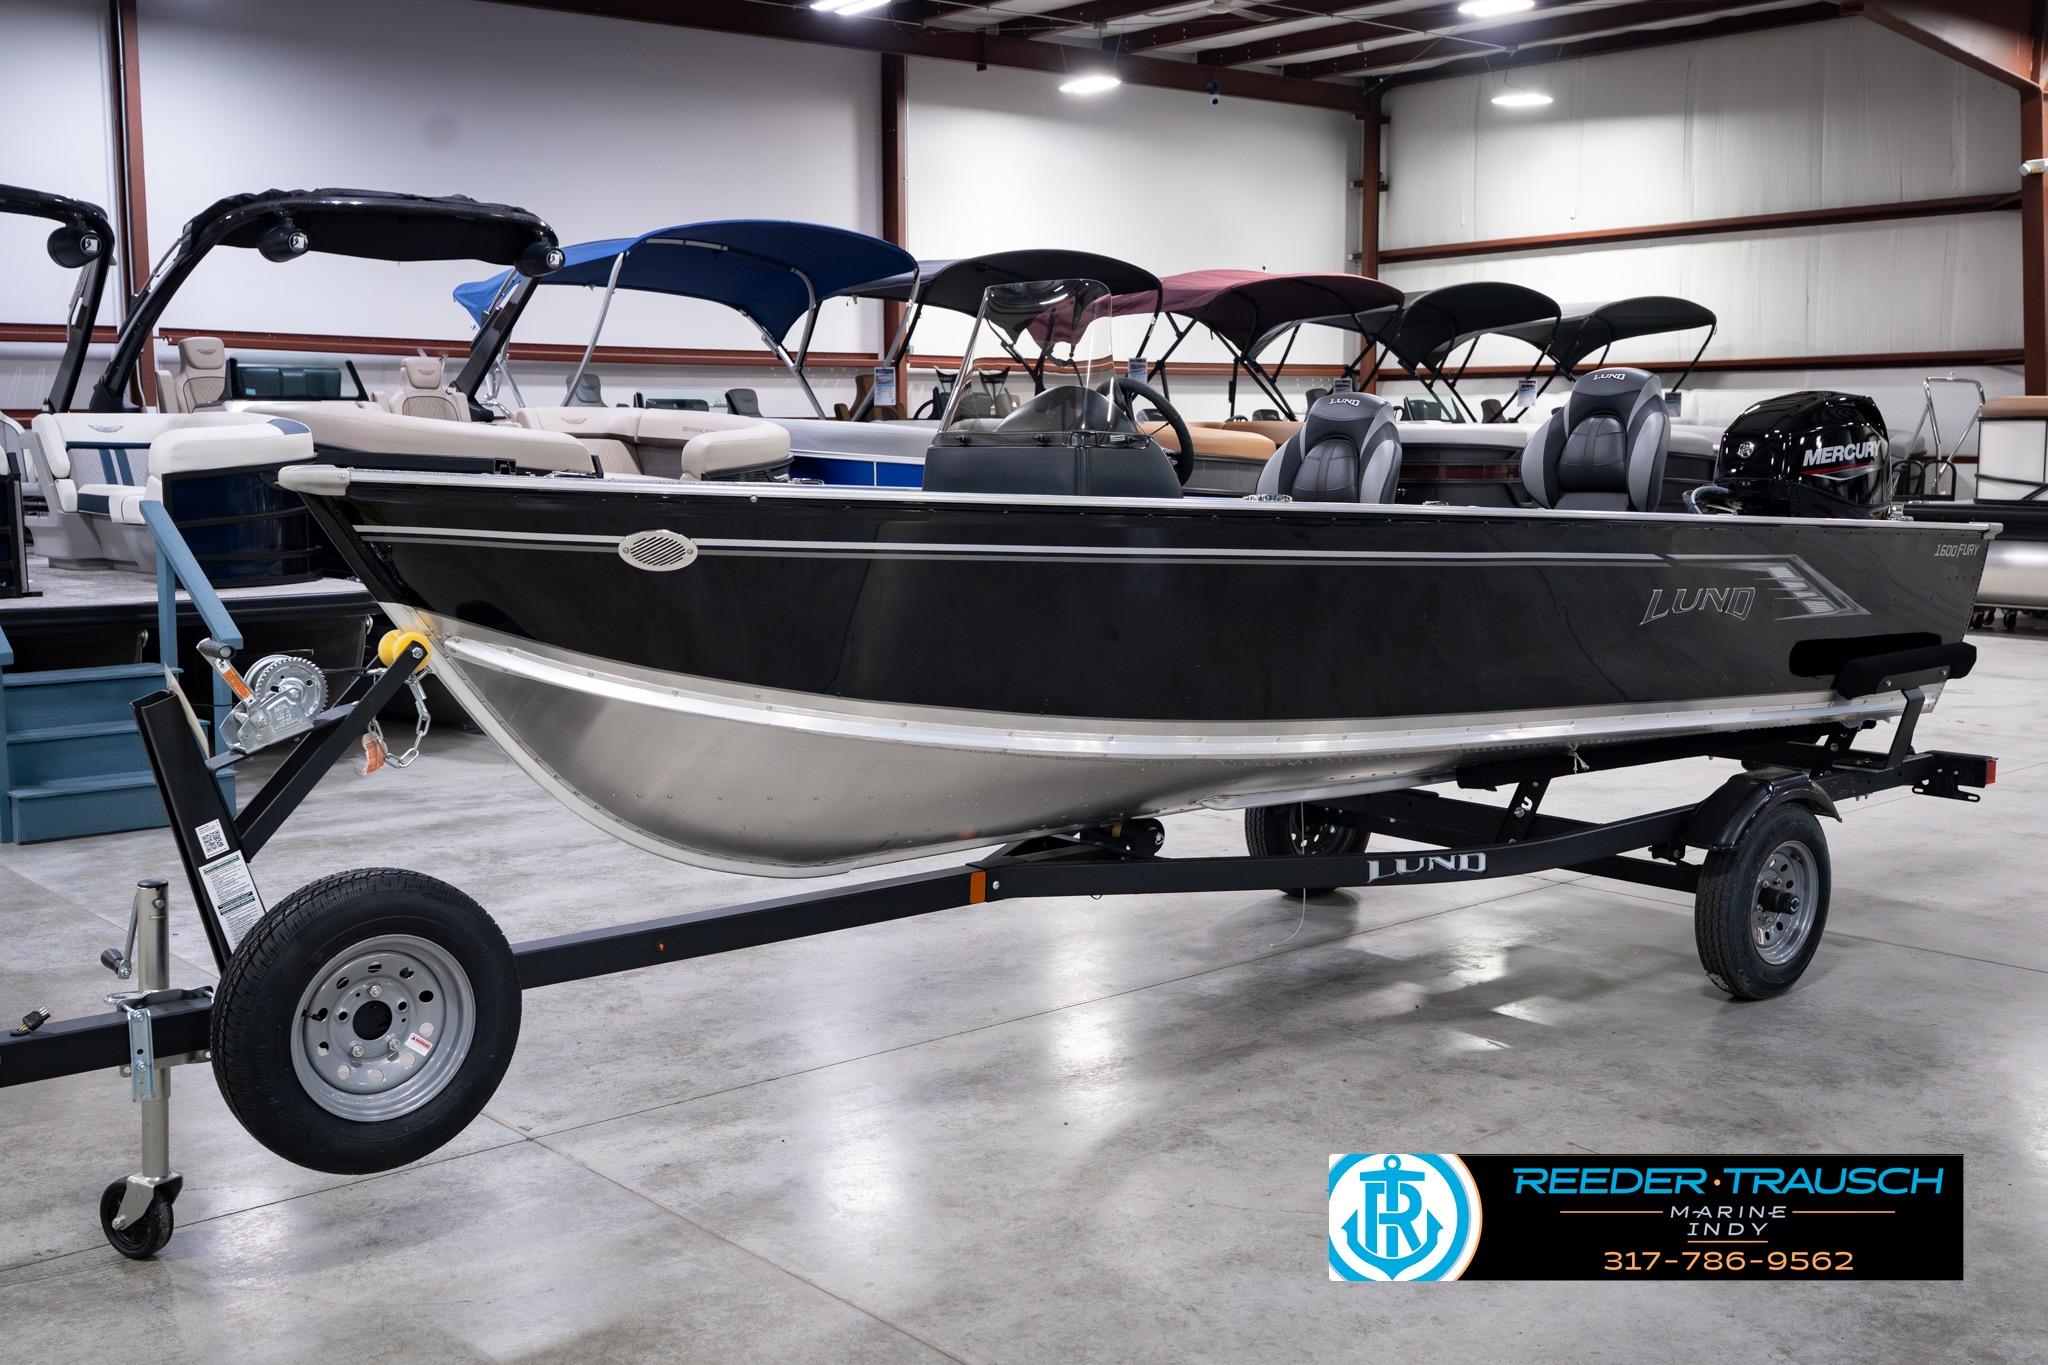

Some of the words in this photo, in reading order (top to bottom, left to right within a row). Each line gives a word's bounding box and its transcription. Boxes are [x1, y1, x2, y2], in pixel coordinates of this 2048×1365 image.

[1329, 398, 1361, 407] LUND
[1803, 441, 1881, 466] MERCURY
[1934, 544, 1958, 557] 1600
[1956, 543, 1980, 558] FURY
[1639, 587, 1756, 626] LUND
[1367, 852, 1486, 884] LUND
